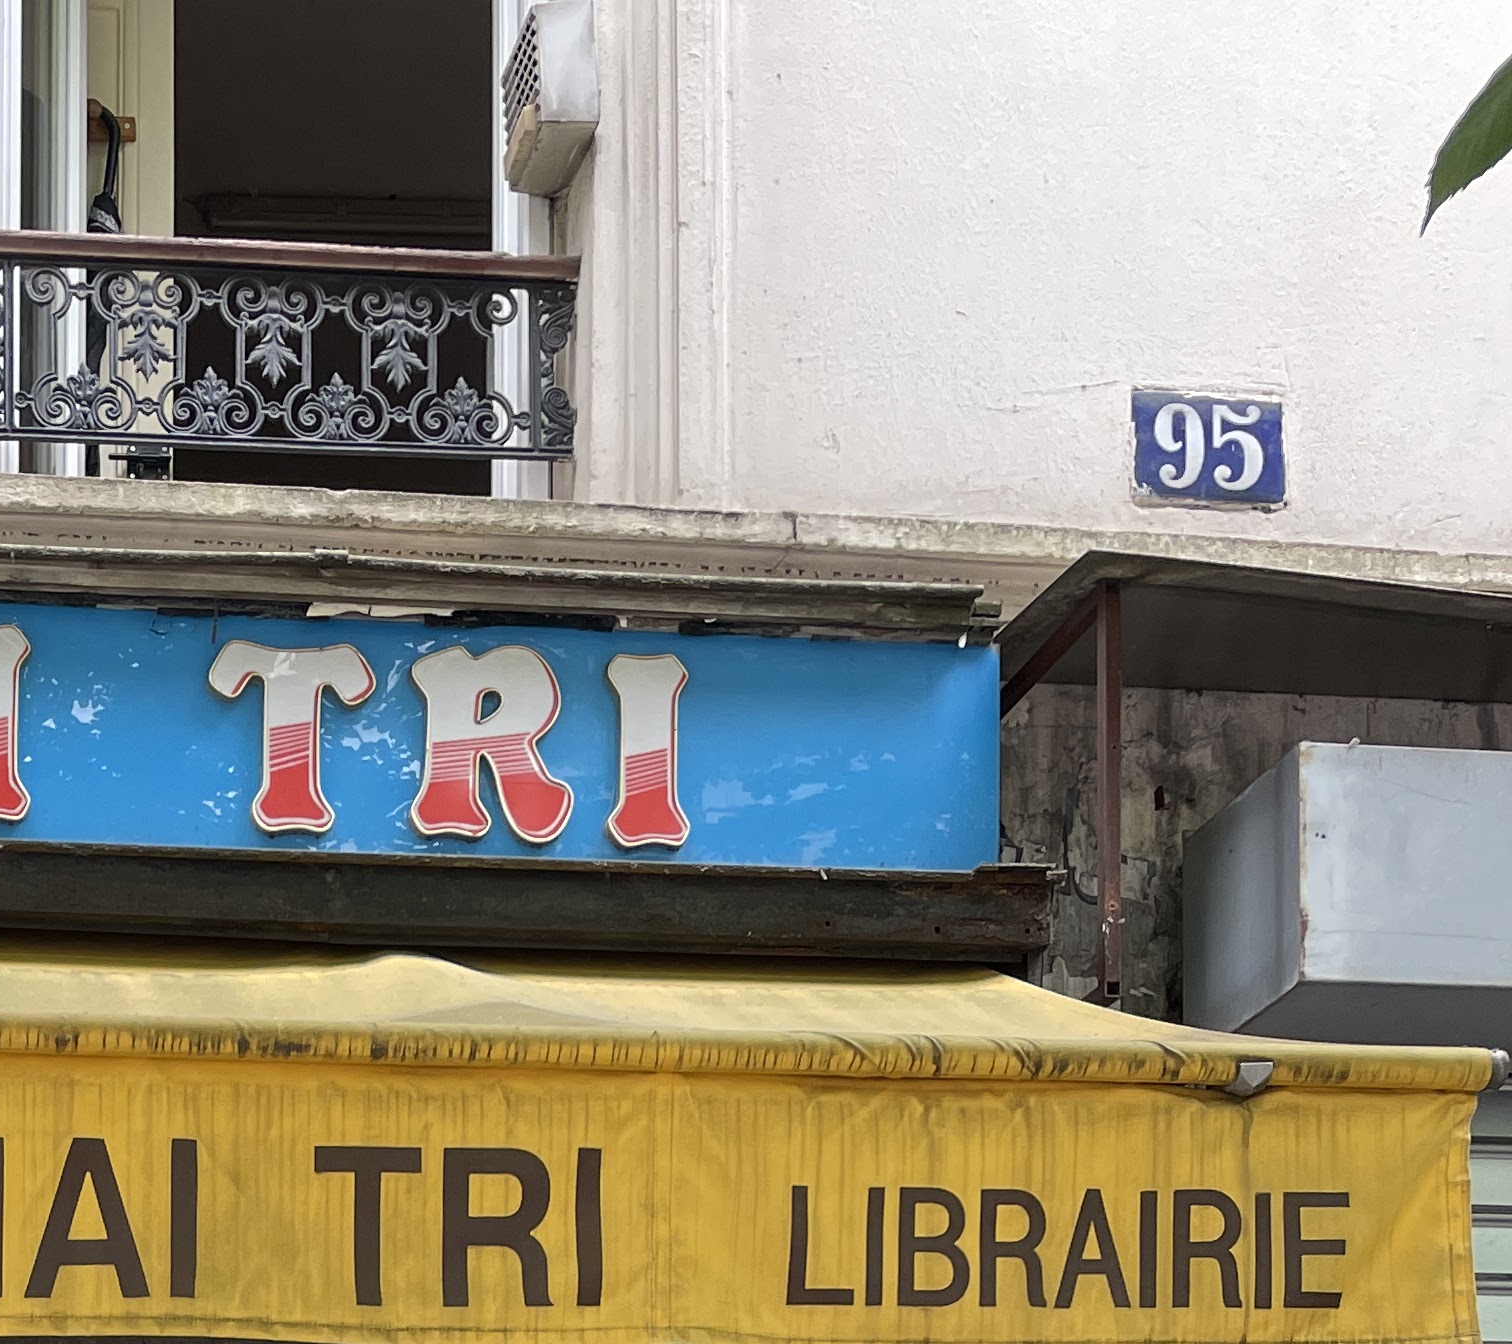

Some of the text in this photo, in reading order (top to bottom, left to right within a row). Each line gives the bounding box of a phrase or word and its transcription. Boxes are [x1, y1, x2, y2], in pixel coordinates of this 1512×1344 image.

[1153, 402, 1264, 492] 95
[208, 640, 690, 848] TRI
[314, 1146, 603, 1308] TRI
[785, 1183, 1350, 1309] LIBRAIRIE
